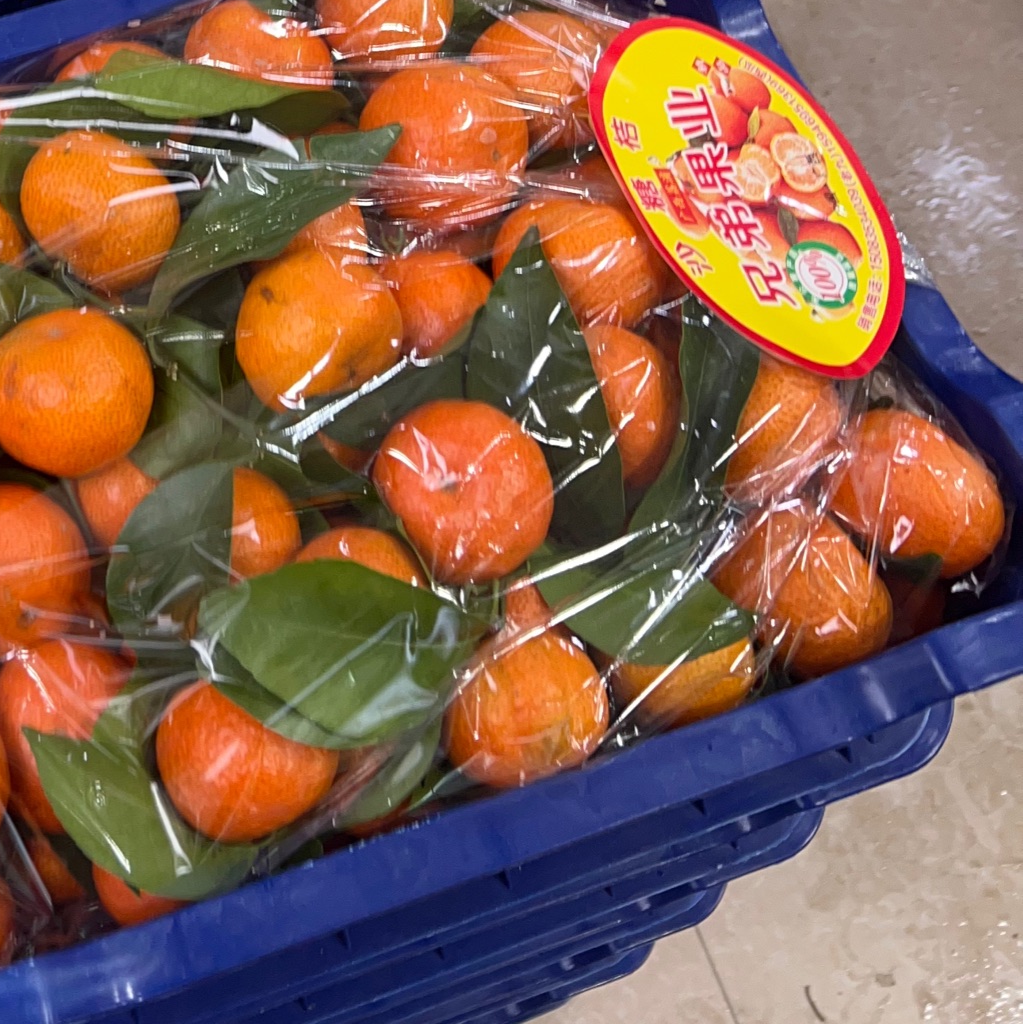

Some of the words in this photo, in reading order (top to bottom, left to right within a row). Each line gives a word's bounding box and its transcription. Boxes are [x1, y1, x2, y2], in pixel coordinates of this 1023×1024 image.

[610, 116, 714, 280] 沙糖桔
[664, 86, 801, 310] 兄弟果业
